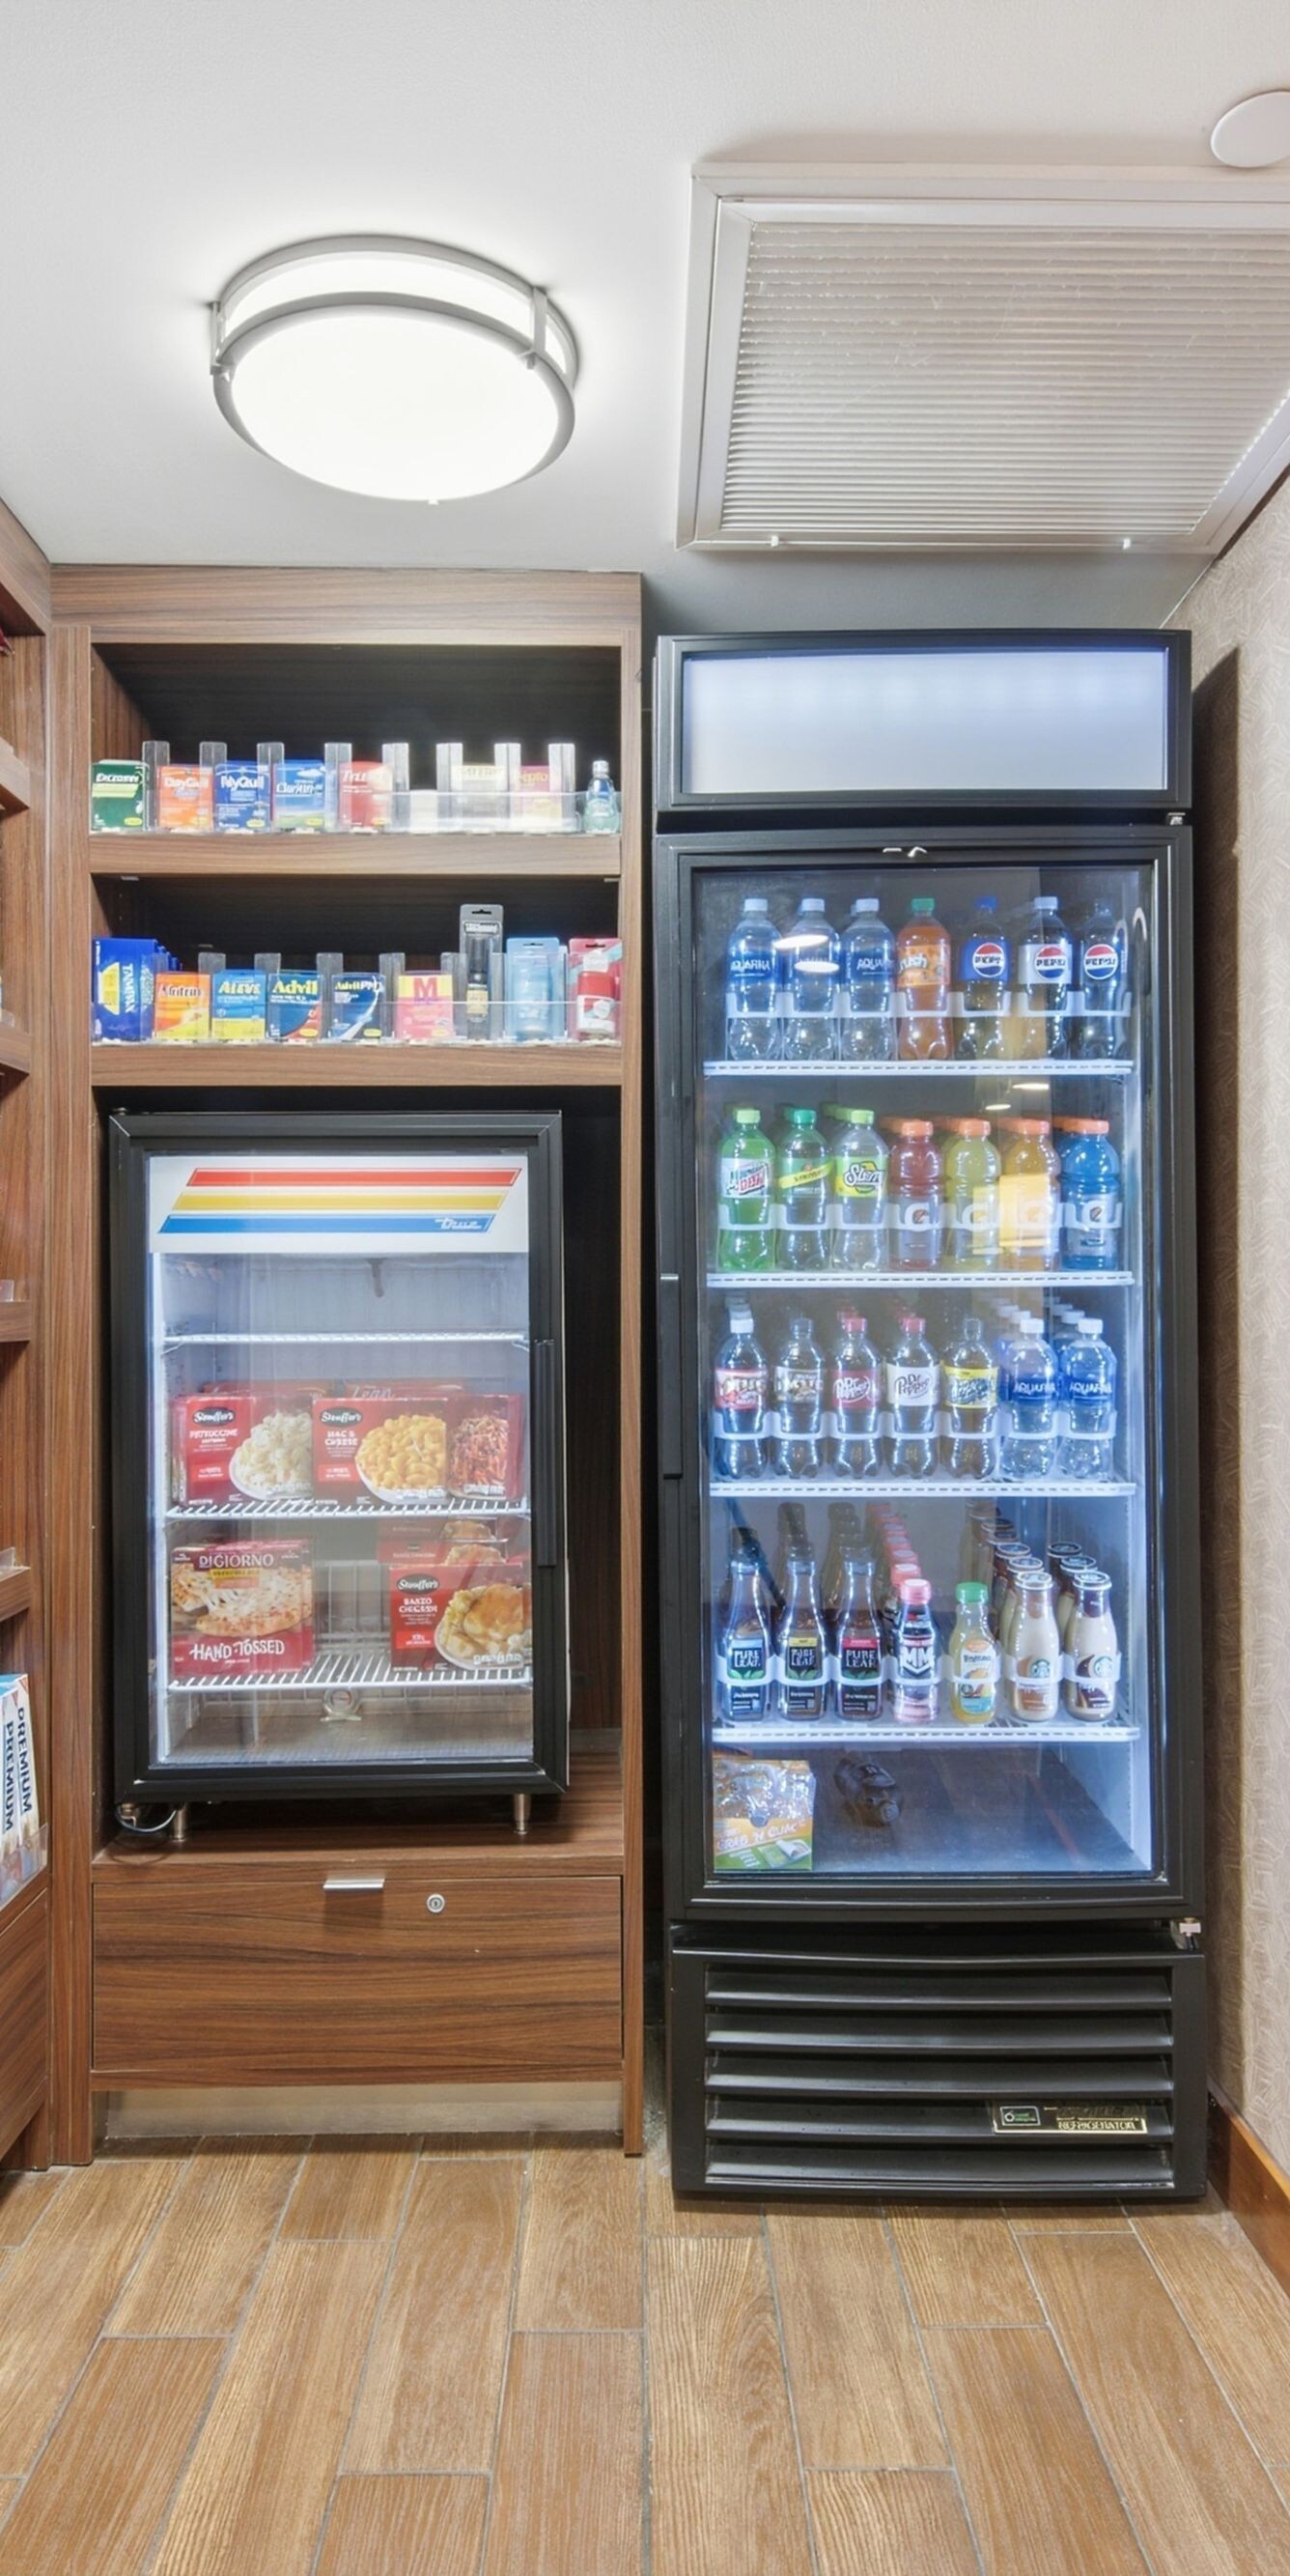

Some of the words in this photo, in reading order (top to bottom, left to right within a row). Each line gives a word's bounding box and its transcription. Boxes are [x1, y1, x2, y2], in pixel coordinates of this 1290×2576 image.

[272, 979, 319, 996] Advil
[189, 1639, 285, 1661] HAND-TOSSED
[846, 1650, 876, 1658] PURE
[18, 1708, 32, 1813] PREMIUM
